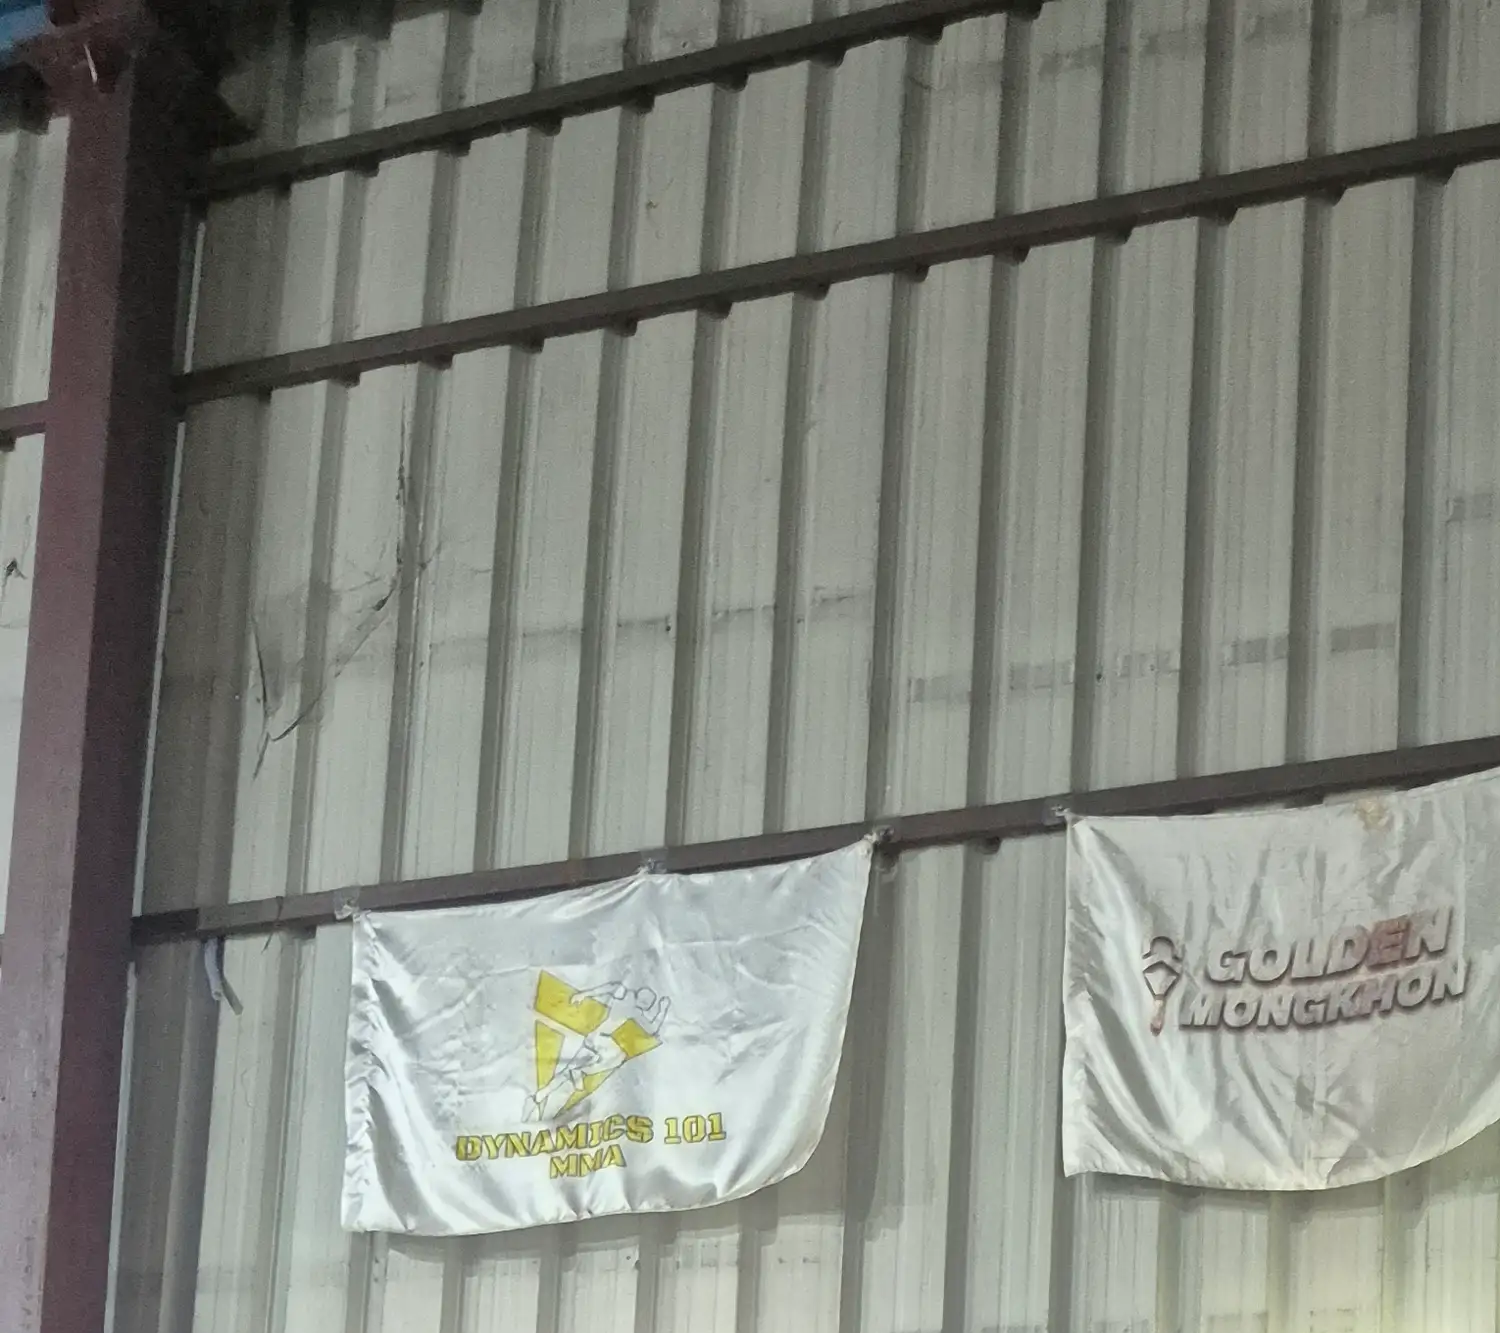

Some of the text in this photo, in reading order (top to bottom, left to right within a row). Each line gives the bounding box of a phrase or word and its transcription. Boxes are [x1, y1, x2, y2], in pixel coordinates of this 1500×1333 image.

[1202, 905, 1455, 987] GOLDEN
[1179, 957, 1473, 1033] MONGKHON
[455, 1111, 727, 1161] DYNAMICS 101
[549, 1144, 627, 1179] MMA
